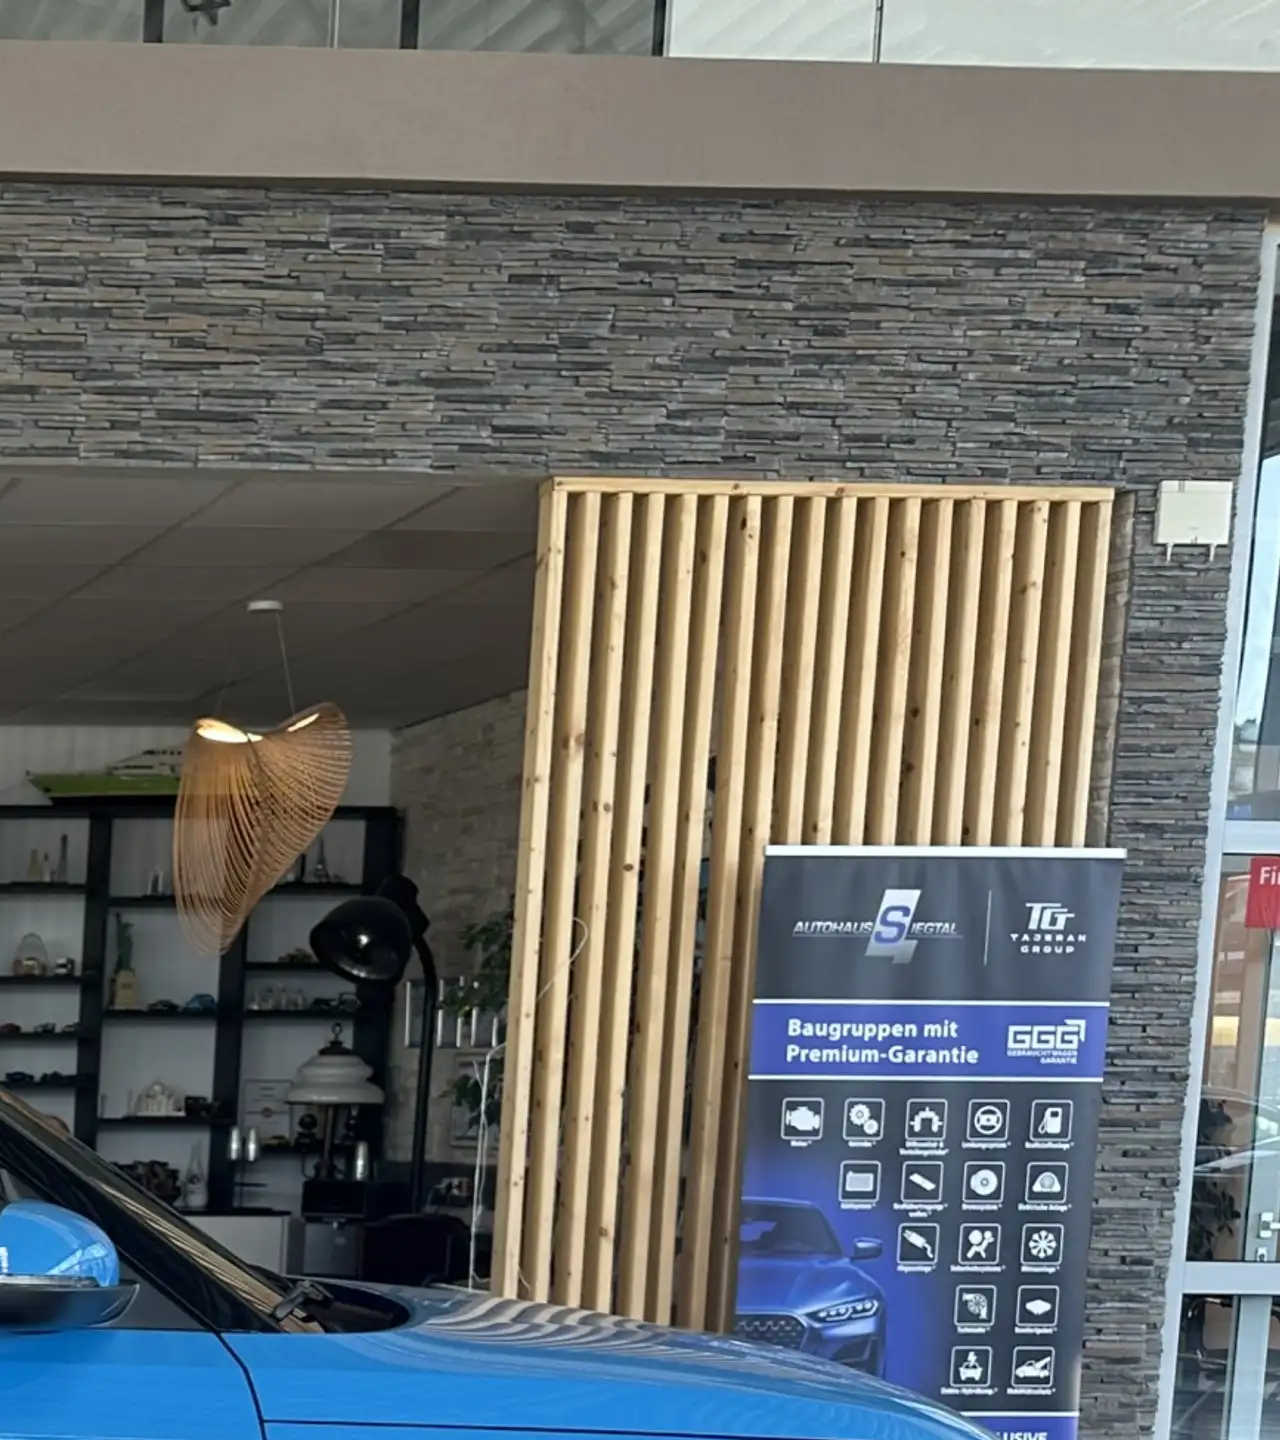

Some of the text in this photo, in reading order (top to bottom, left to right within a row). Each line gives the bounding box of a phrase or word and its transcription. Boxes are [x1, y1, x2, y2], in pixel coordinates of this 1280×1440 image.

[793, 920, 875, 934] AUTOHAUS
[1020, 945, 1075, 954] GROUP
[787, 1018, 959, 1042] Baugruppen mit
[1007, 1025, 1079, 1050] GGG
[786, 1044, 979, 1064] Premium-Garantie
